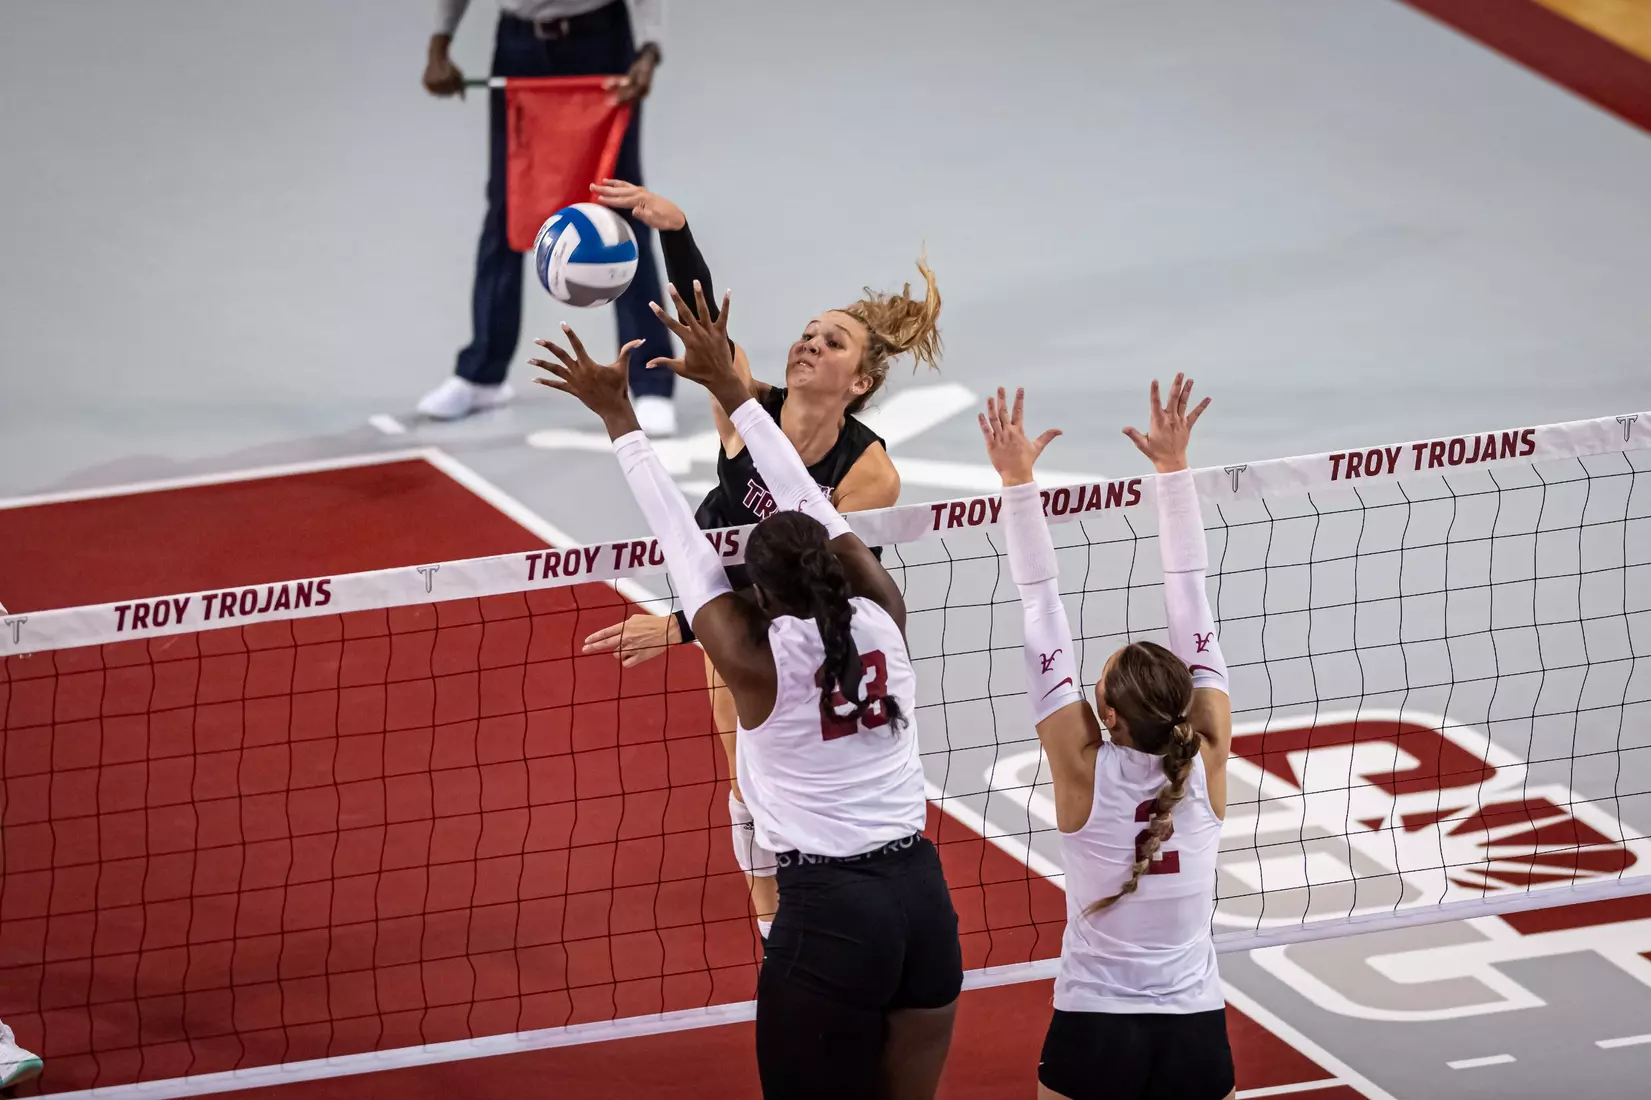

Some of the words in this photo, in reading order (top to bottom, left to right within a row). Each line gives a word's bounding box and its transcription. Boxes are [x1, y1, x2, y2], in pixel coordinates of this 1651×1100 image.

[1328, 447, 1402, 481] TROY
[1411, 429, 1536, 471] TROJANS
[930, 496, 1002, 531] TROY
[1039, 478, 1142, 518] ROJANS
[525, 545, 602, 581] TROY
[114, 597, 191, 632] TROY
[201, 578, 332, 621] TROJANS
[1134, 798, 1181, 875] 2
